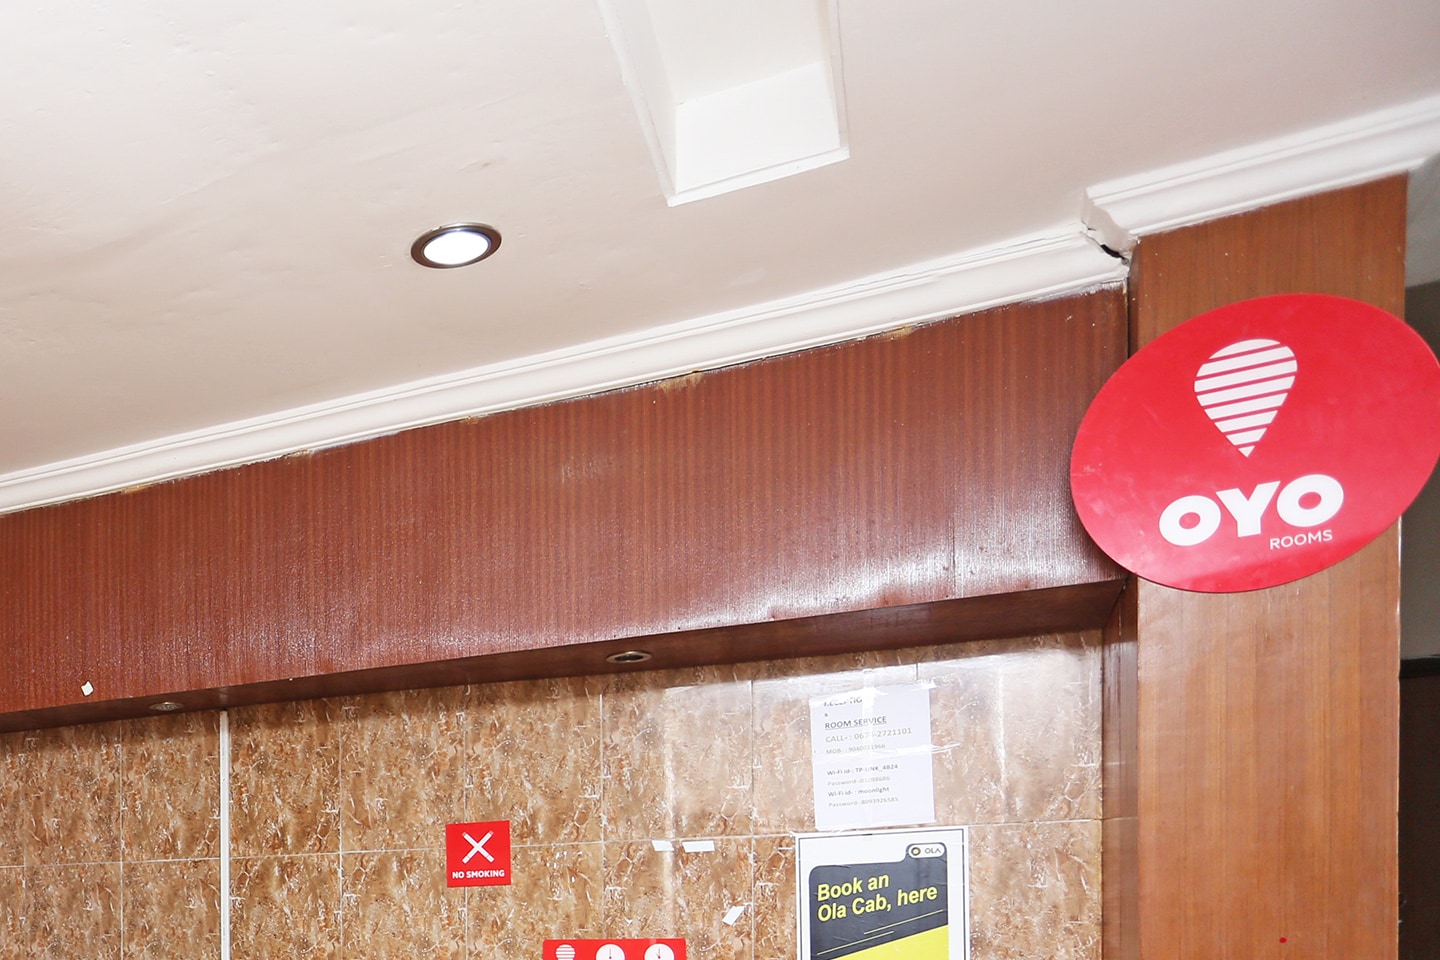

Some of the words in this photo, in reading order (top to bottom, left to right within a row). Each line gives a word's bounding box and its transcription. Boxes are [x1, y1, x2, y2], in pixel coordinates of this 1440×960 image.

[1159, 473, 1345, 547] OYO
[1269, 529, 1334, 551] ROOMS
[825, 719, 852, 730] ROOM
[853, 716, 888, 727] SERVICE
[452, 871, 465, 879] NO
[466, 869, 505, 879] SMOKING
[817, 876, 863, 902] Book
[867, 874, 890, 892] an
[817, 902, 848, 922] Ola
[852, 895, 892, 914] Cab,
[897, 886, 938, 906] here
